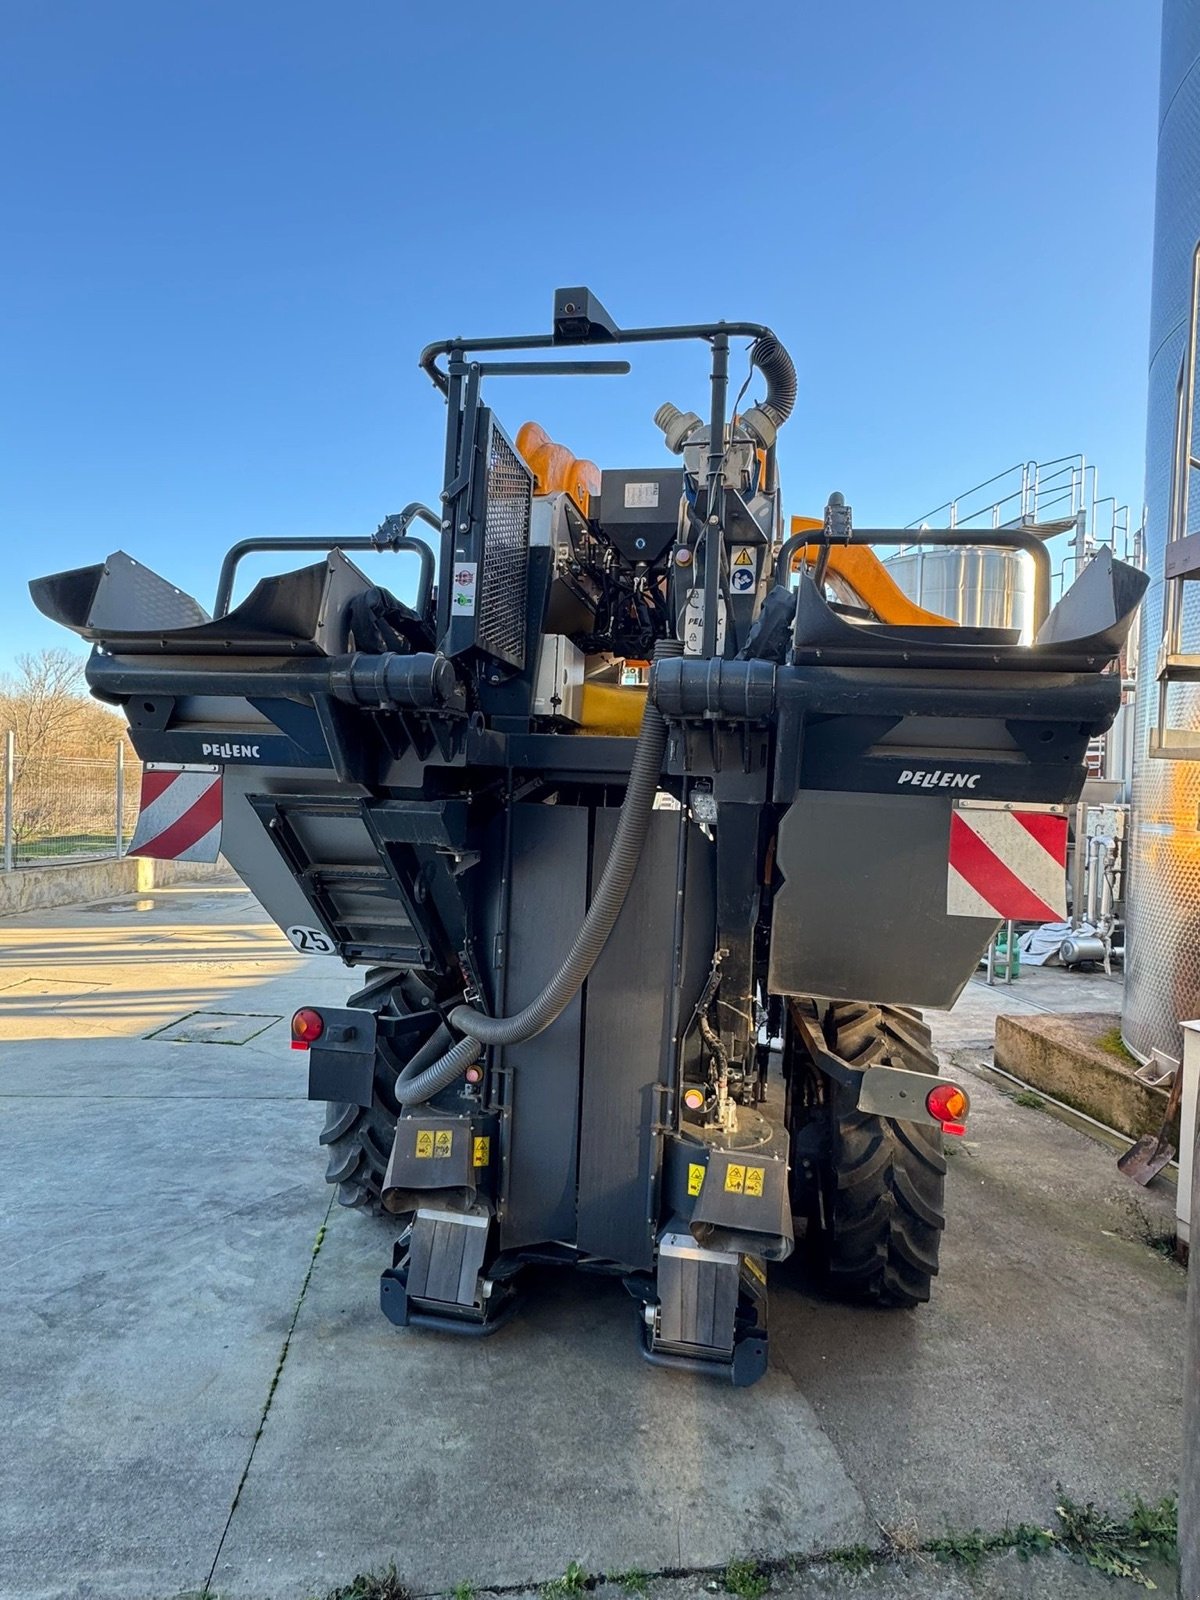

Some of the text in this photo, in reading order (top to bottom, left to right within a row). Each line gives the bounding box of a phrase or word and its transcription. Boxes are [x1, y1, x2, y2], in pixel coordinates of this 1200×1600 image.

[688, 618, 723, 627] PELC
[202, 743, 260, 758] PELLENC
[897, 770, 981, 789] PELLENC
[292, 929, 330, 952] 25
